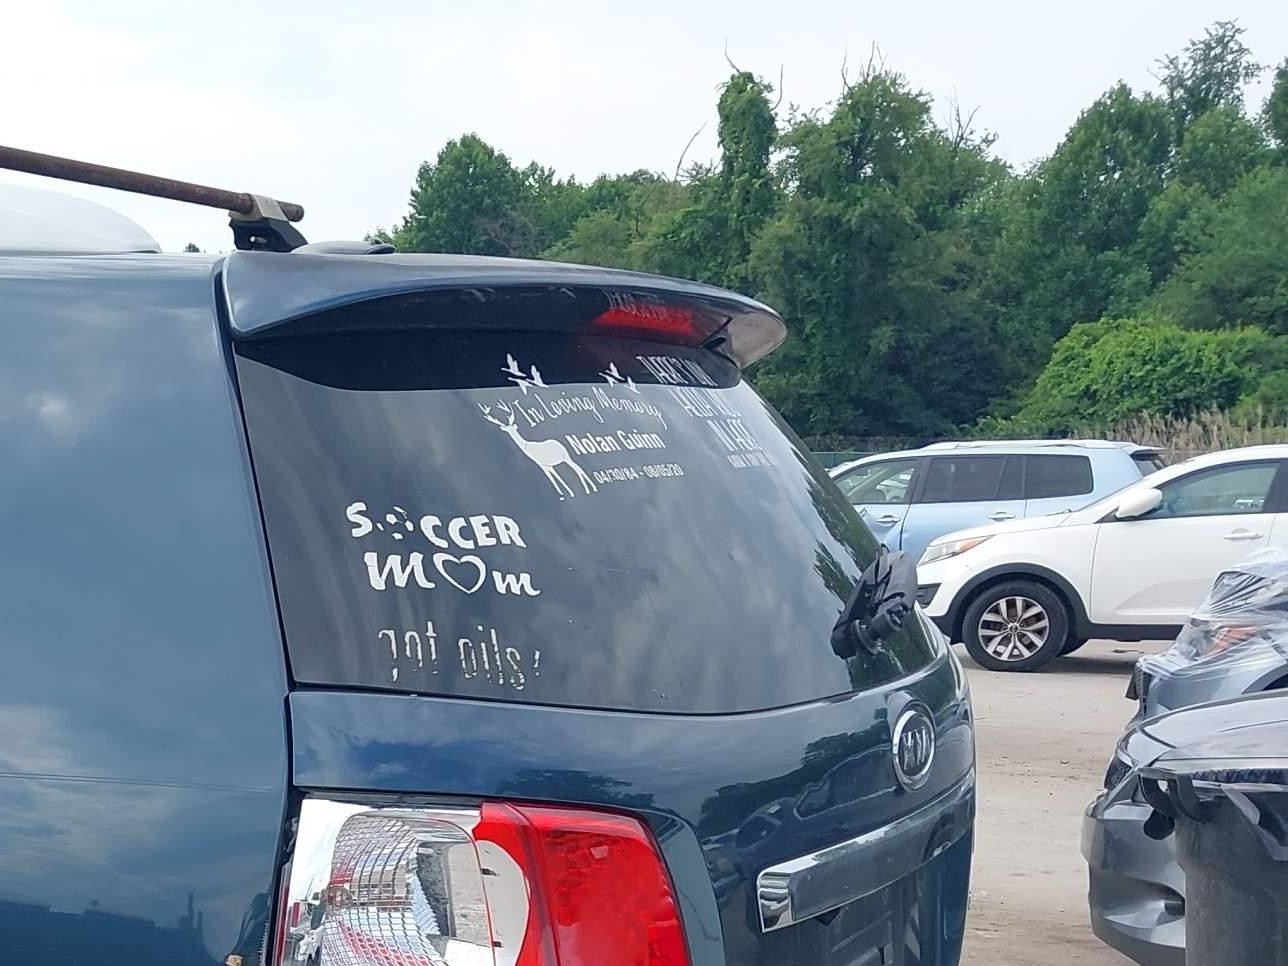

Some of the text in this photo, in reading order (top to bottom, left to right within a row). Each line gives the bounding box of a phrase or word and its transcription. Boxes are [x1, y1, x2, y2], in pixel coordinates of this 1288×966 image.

[512, 386, 668, 430] In Loving Memory
[564, 429, 666, 456] Nolan Guinn
